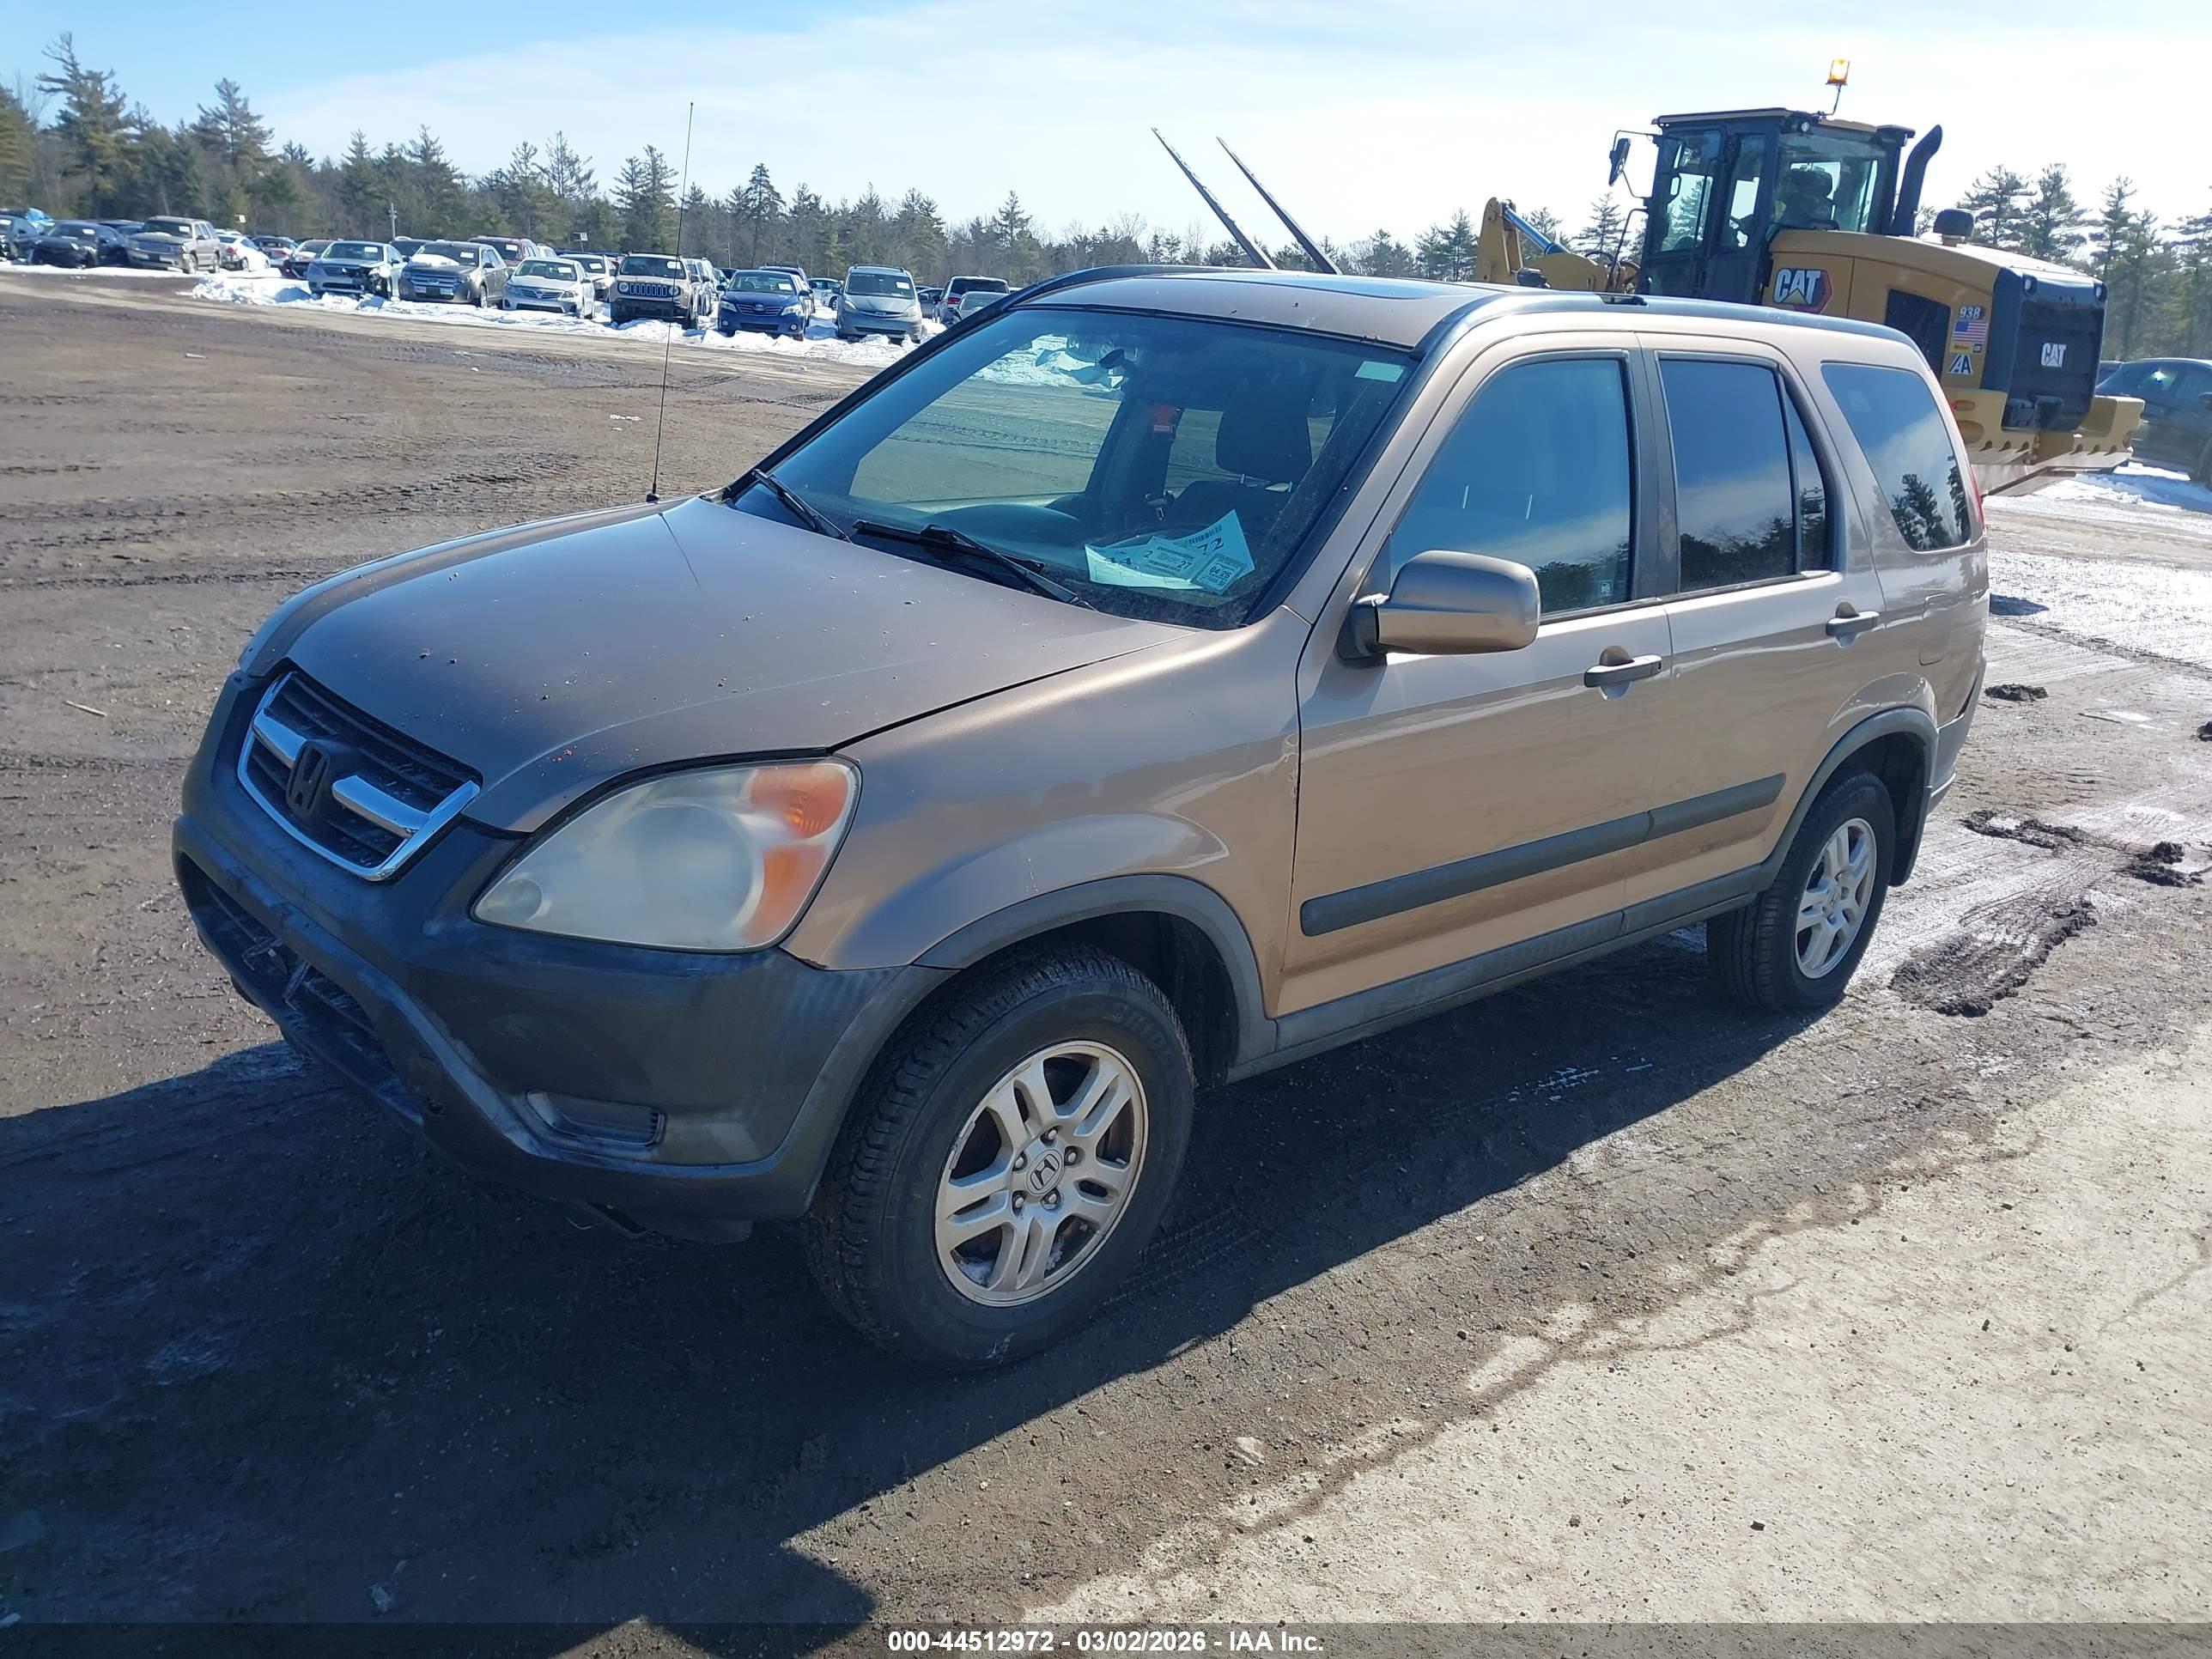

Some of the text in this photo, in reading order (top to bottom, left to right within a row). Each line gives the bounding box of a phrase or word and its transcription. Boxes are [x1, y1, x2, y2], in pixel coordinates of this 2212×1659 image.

[1774, 269, 1821, 304] CAT
[1960, 306, 1981, 319] 938
[2040, 343, 2067, 368] CAT
[1177, 561, 1192, 569] 27
